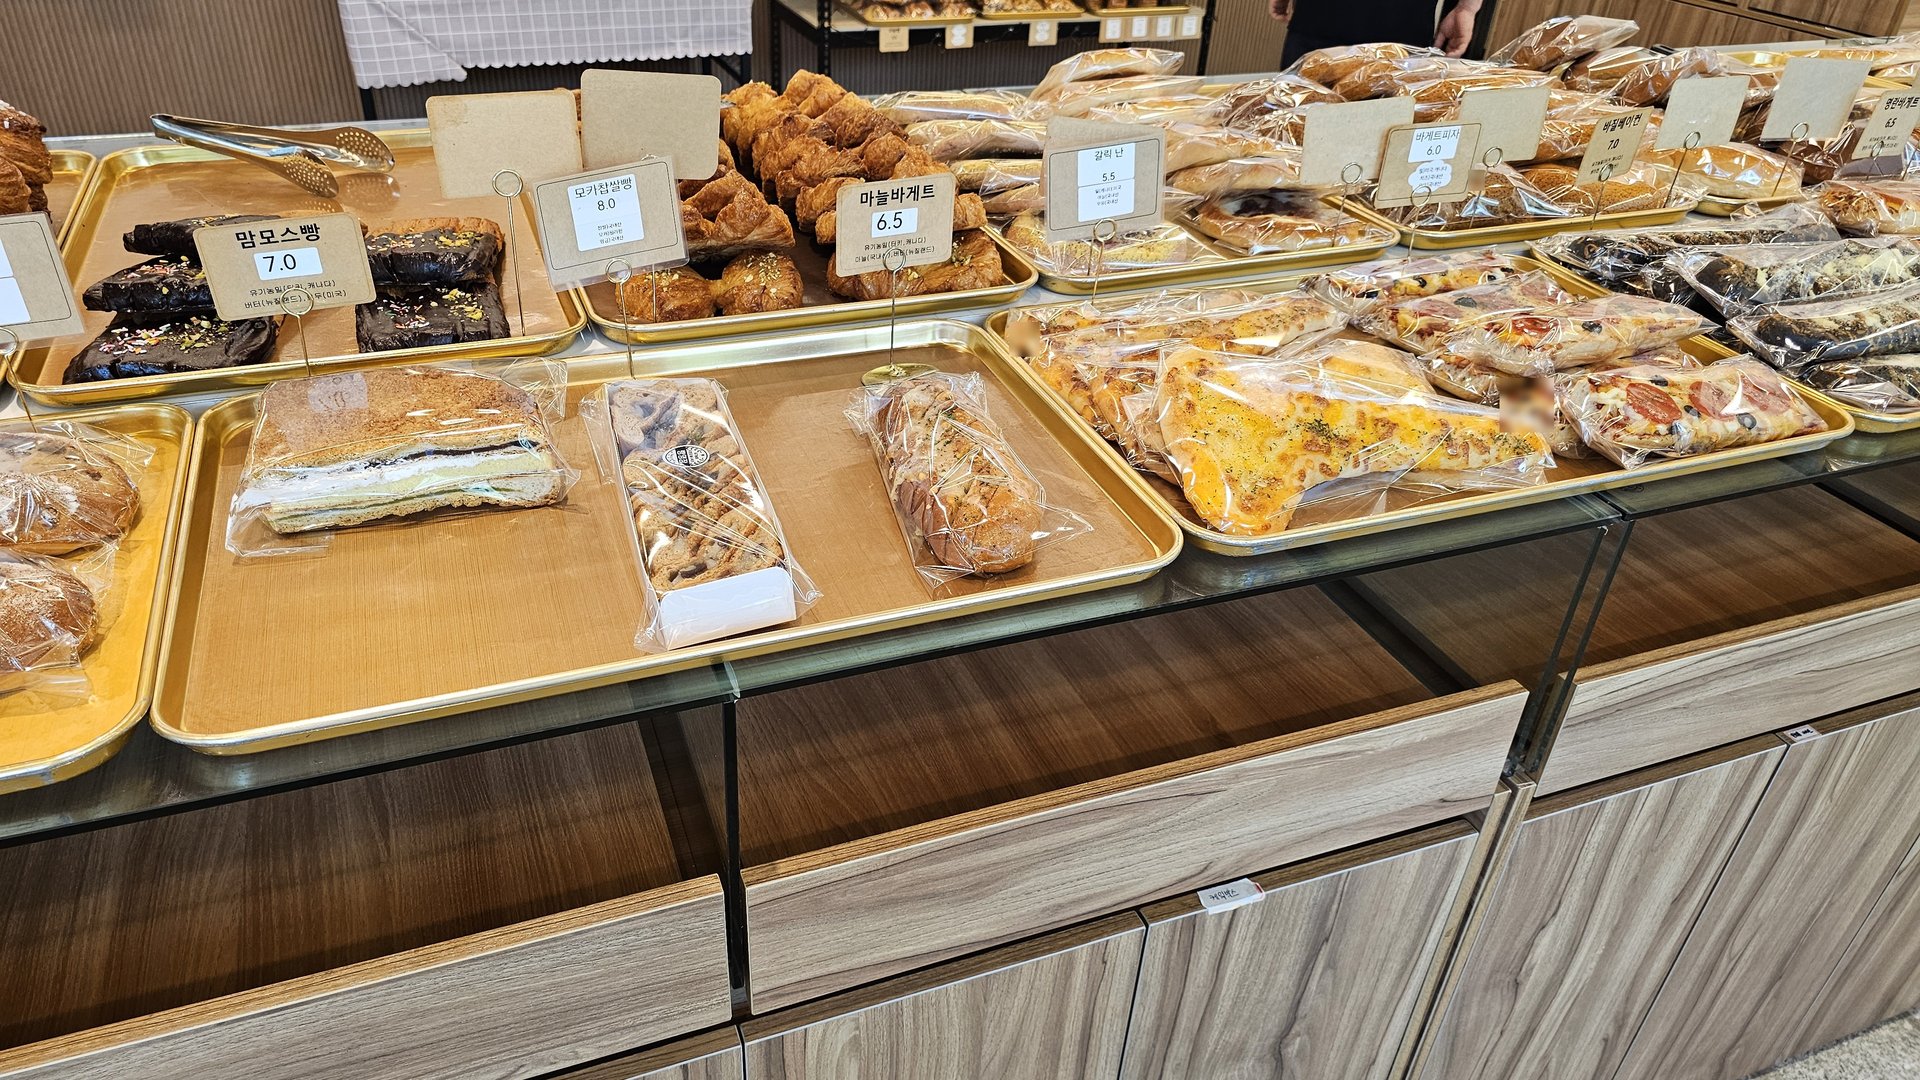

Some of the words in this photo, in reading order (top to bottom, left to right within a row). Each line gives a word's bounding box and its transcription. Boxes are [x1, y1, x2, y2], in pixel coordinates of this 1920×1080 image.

[1602, 113, 1643, 133] 바질베이컨
[1415, 129, 1460, 143] 바게트피자
[1094, 149, 1112, 161] 갈릭
[1115, 147, 1124, 158] 난
[1426, 144, 1442, 156] 6.0
[1102, 171, 1116, 182] 5.5
[574, 177, 632, 198] 모카찹쌀빵
[860, 184, 936, 207] 마늘바게트
[597, 197, 616, 211] 8.0
[876, 211, 903, 230] 6.5
[234, 223, 321, 249] 맘모스빵
[262, 253, 297, 273] 7.0
